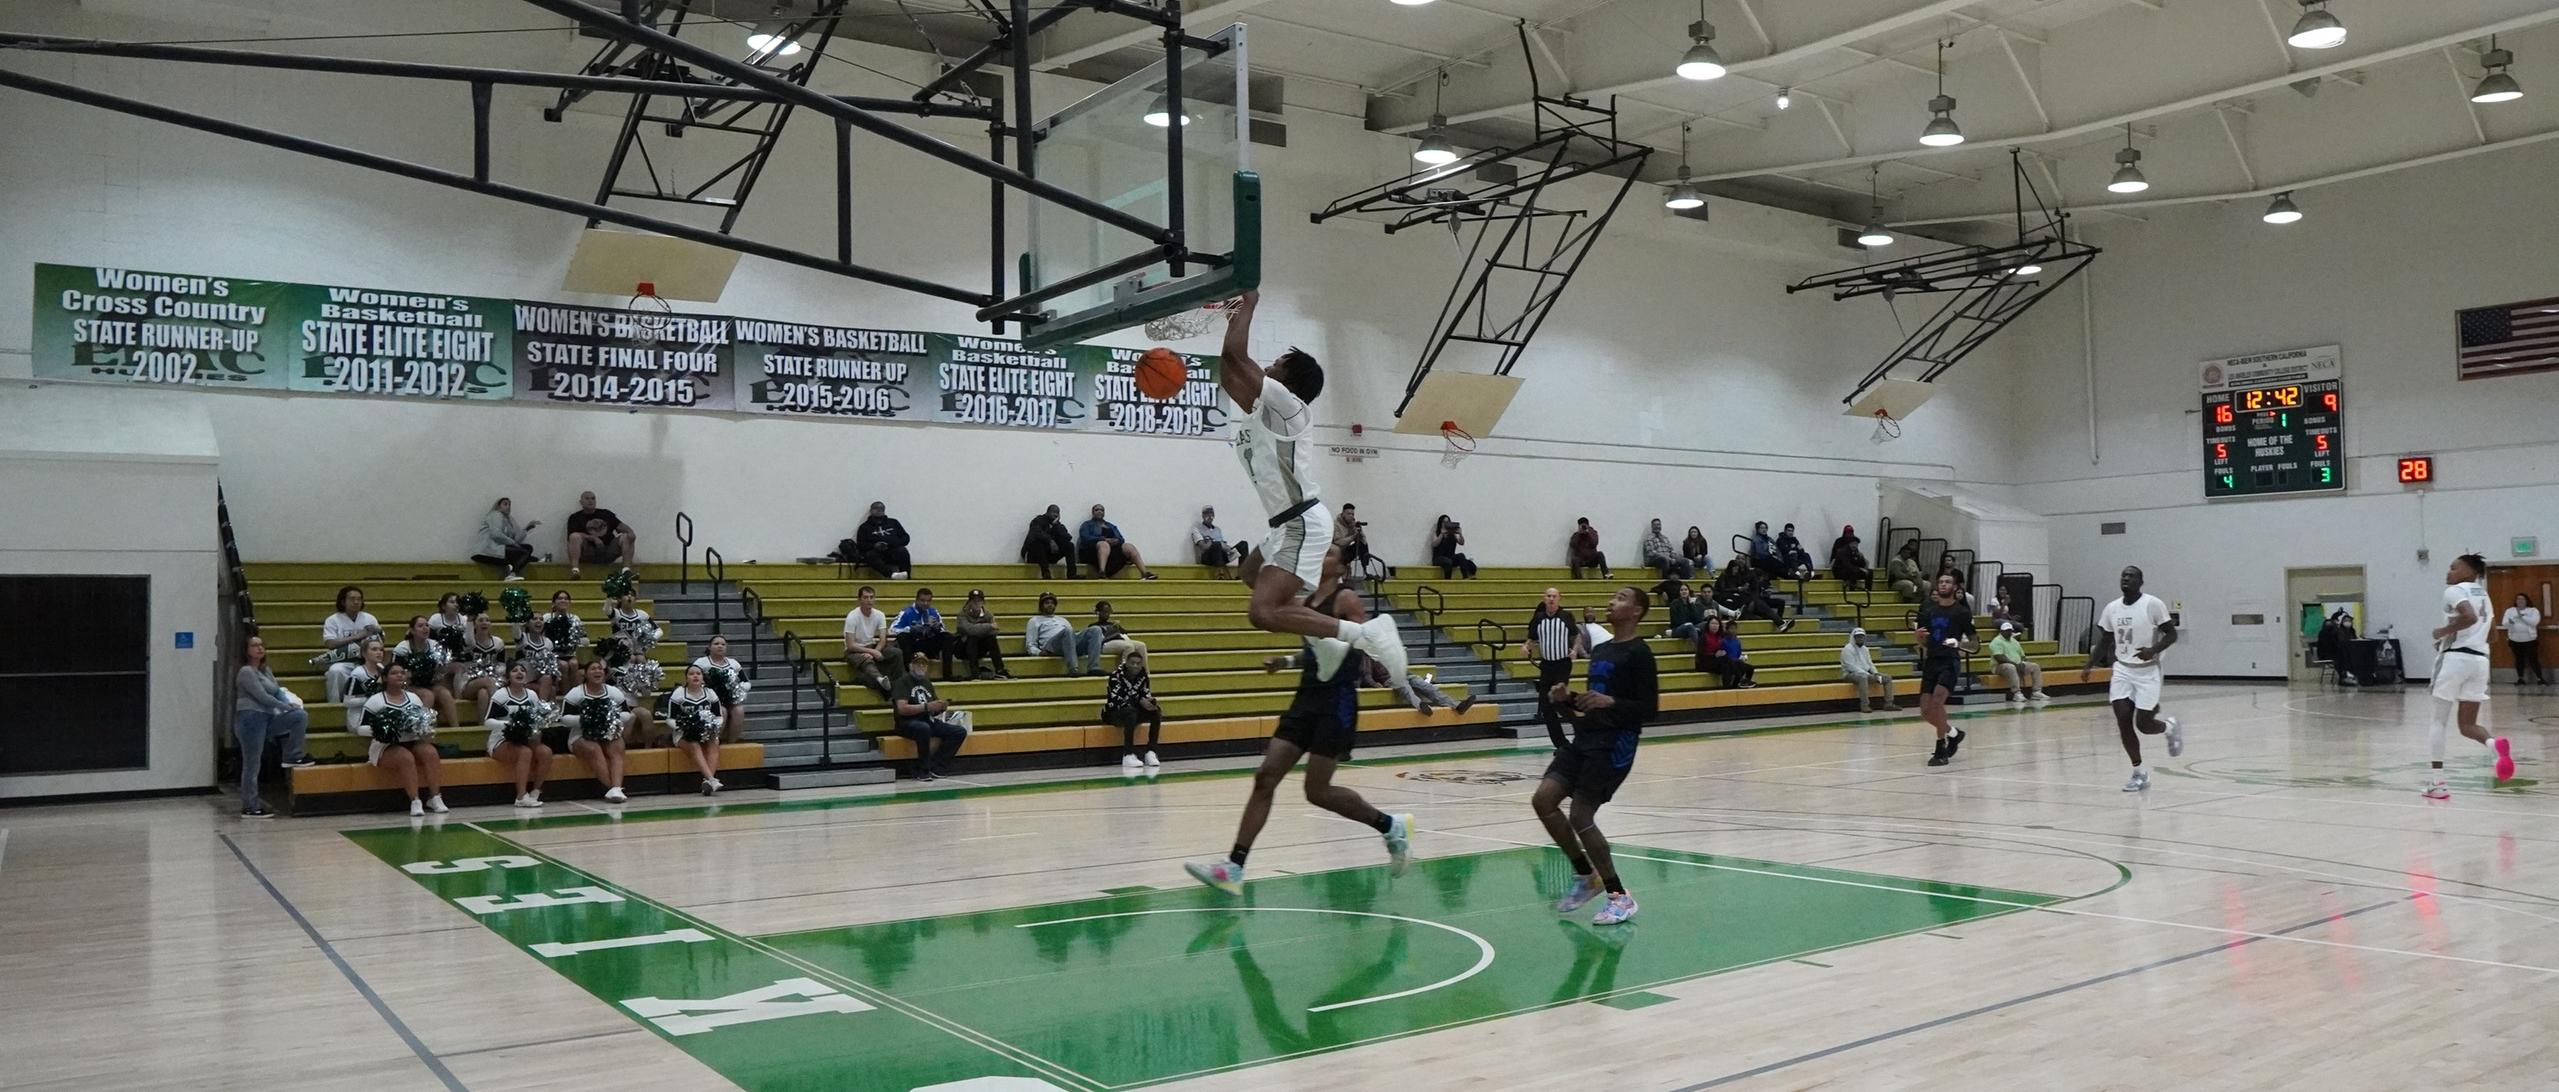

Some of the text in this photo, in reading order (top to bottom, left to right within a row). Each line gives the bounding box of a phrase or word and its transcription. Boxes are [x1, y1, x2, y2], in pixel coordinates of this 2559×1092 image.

[96, 268, 229, 297] Women's
[61, 290, 266, 325] Cross Country
[328, 287, 469, 311] Women's
[321, 304, 483, 329] Basketball
[514, 304, 729, 344] WOMEN'S BASKETBALL
[73, 319, 259, 353] STATE RUNNER-UP
[301, 319, 494, 362] STATE ELITE EIGHT
[735, 319, 927, 355] WOMEN'S BASKETBALL
[132, 351, 197, 384] 2002
[527, 341, 718, 373] STATE FINAL FOUR
[764, 354, 907, 383] STATE RUNNER UP
[952, 349, 1067, 369] Basketball
[334, 356, 465, 397] 2011-2012
[554, 372, 694, 404] 2014-2015
[939, 363, 1075, 397] STATE ELITE EIGHT
[1095, 374, 1137, 402] STATE
[2303, 382, 2338, 393] VISITOR
[783, 382, 889, 412] 2015-2016
[2206, 393, 2231, 403] HOME
[2246, 387, 2298, 409] 12:42
[2324, 394, 2337, 411] 9
[962, 393, 1057, 427] 2016-2017
[1113, 403, 1203, 435] 2018-2019
[2216, 405, 2233, 423] 16
[2216, 443, 2227, 458] 5
[2247, 435, 2293, 447] HOME OF THE
[2255, 446, 2285, 457] HUSKIES
[2317, 435, 2328, 450] 5
[2314, 450, 2330, 458] LEFT
[2250, 464, 2274, 472] PLAYER
[2321, 467, 2331, 482] 3
[2401, 460, 2428, 480] 28
[2223, 475, 2233, 488] 4
[2118, 628, 2133, 644] 24
